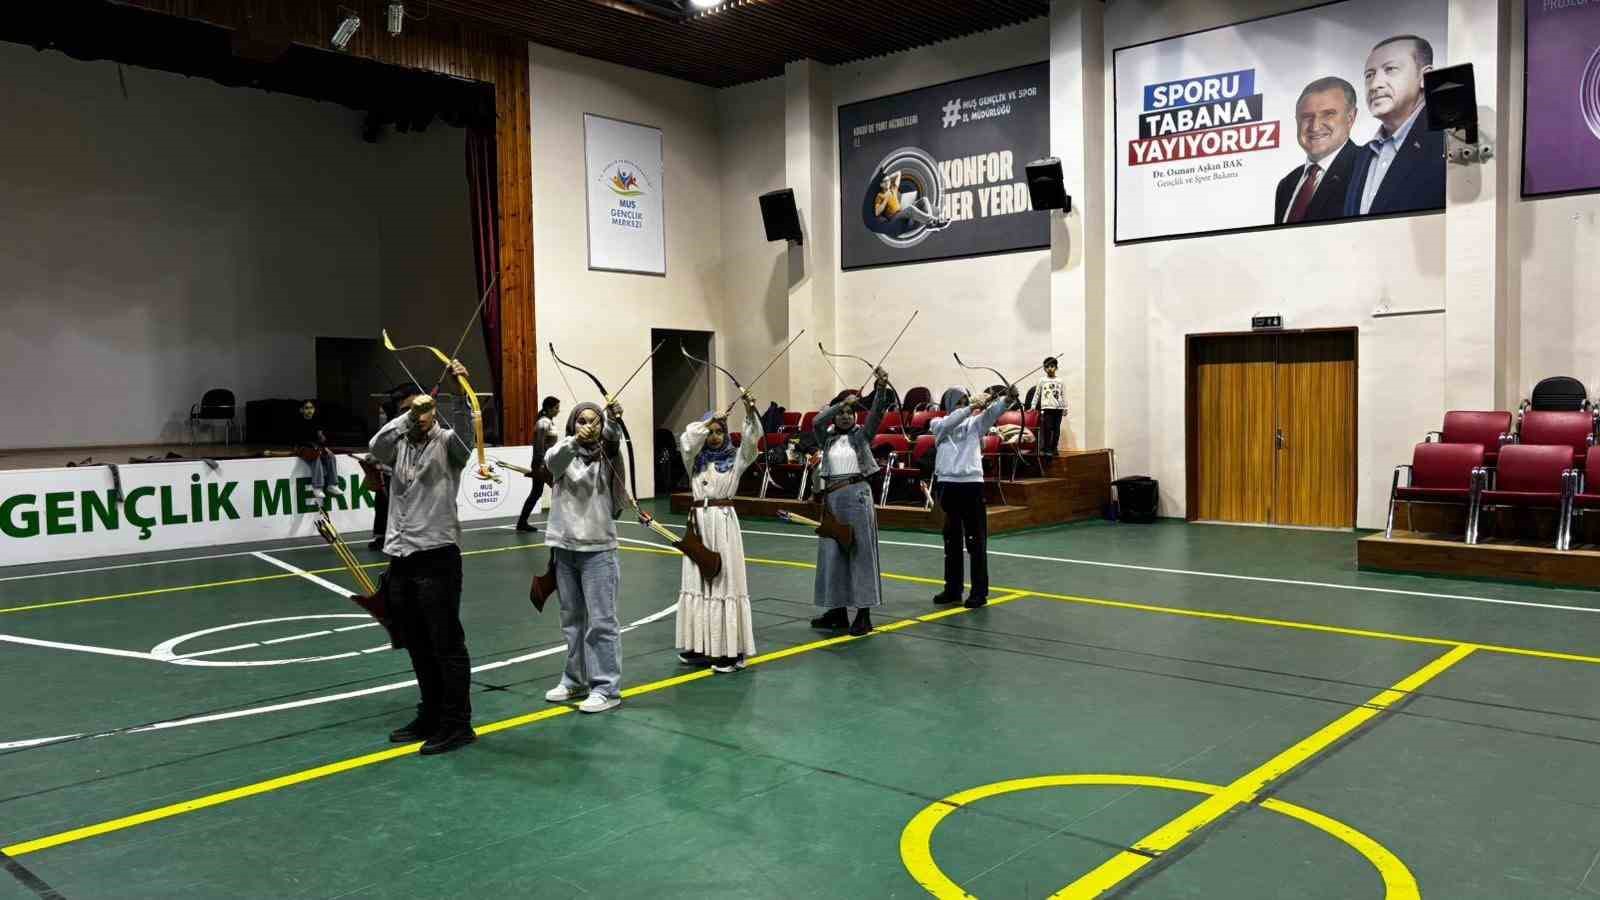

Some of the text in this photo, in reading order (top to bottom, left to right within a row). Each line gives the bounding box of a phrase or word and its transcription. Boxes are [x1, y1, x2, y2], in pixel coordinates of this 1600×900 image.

[1019, 87, 1037, 98] SPOR
[1153, 75, 1240, 108] SPORU
[1147, 99, 1252, 137] TABANA
[1132, 124, 1275, 164] YAYIYORUZ
[938, 150, 1013, 190] KONFOR
[1167, 167, 1195, 177] Osman
[1223, 159, 1243, 169] BAK
[939, 182, 1033, 223] HER YERD
[0, 473, 240, 540] GENÇLİK
